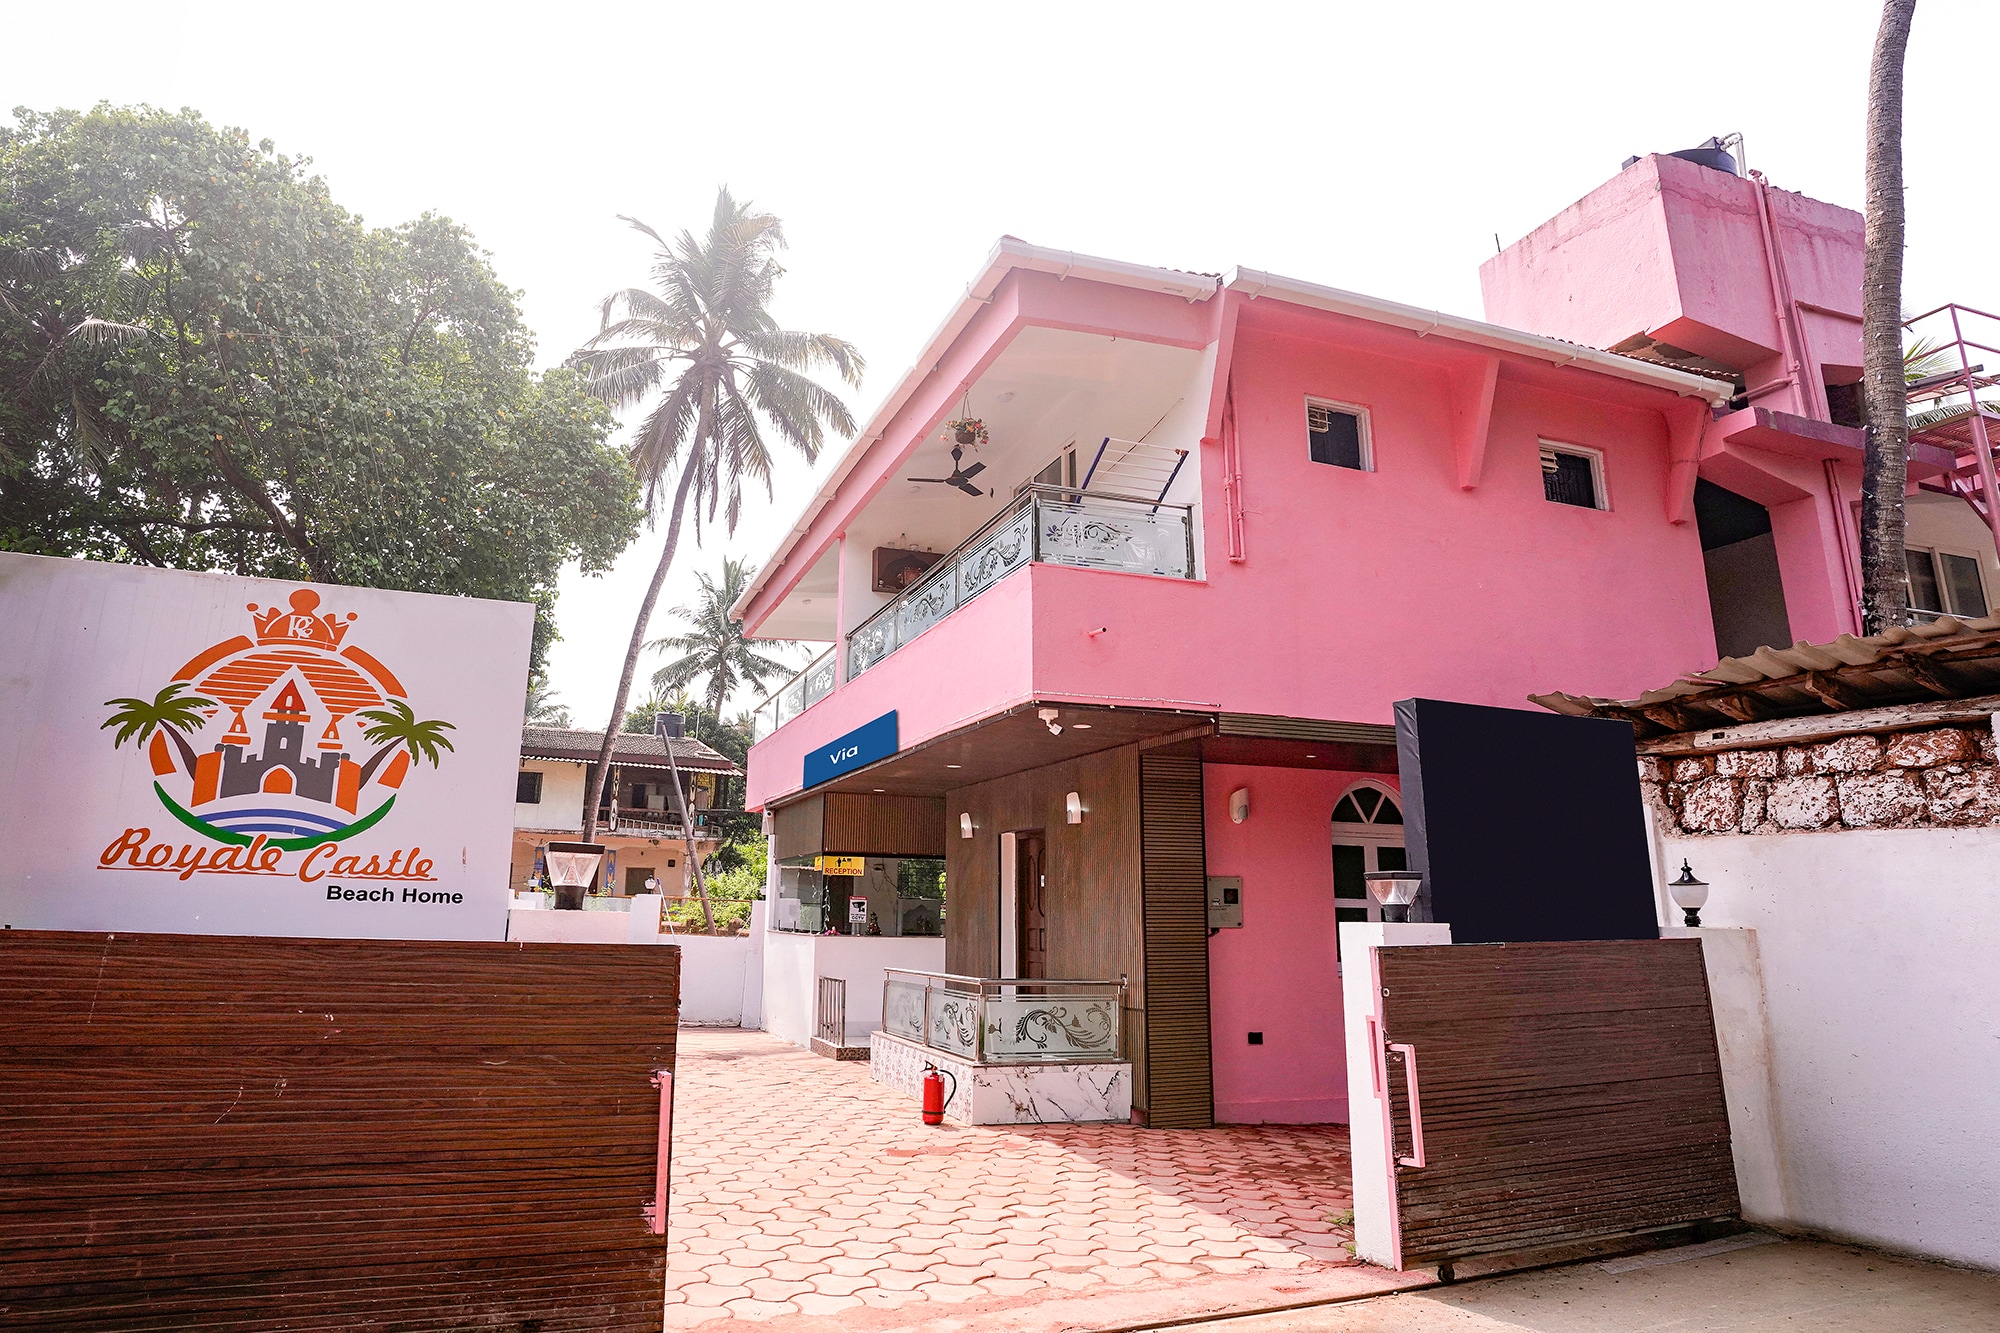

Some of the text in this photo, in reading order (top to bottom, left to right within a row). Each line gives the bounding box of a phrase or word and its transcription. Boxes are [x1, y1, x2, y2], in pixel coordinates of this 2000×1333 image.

[829, 745, 858, 765] Via
[100, 828, 433, 882] Royale Castle
[824, 867, 863, 875] RECEPTION
[326, 885, 464, 905] Beach Home
